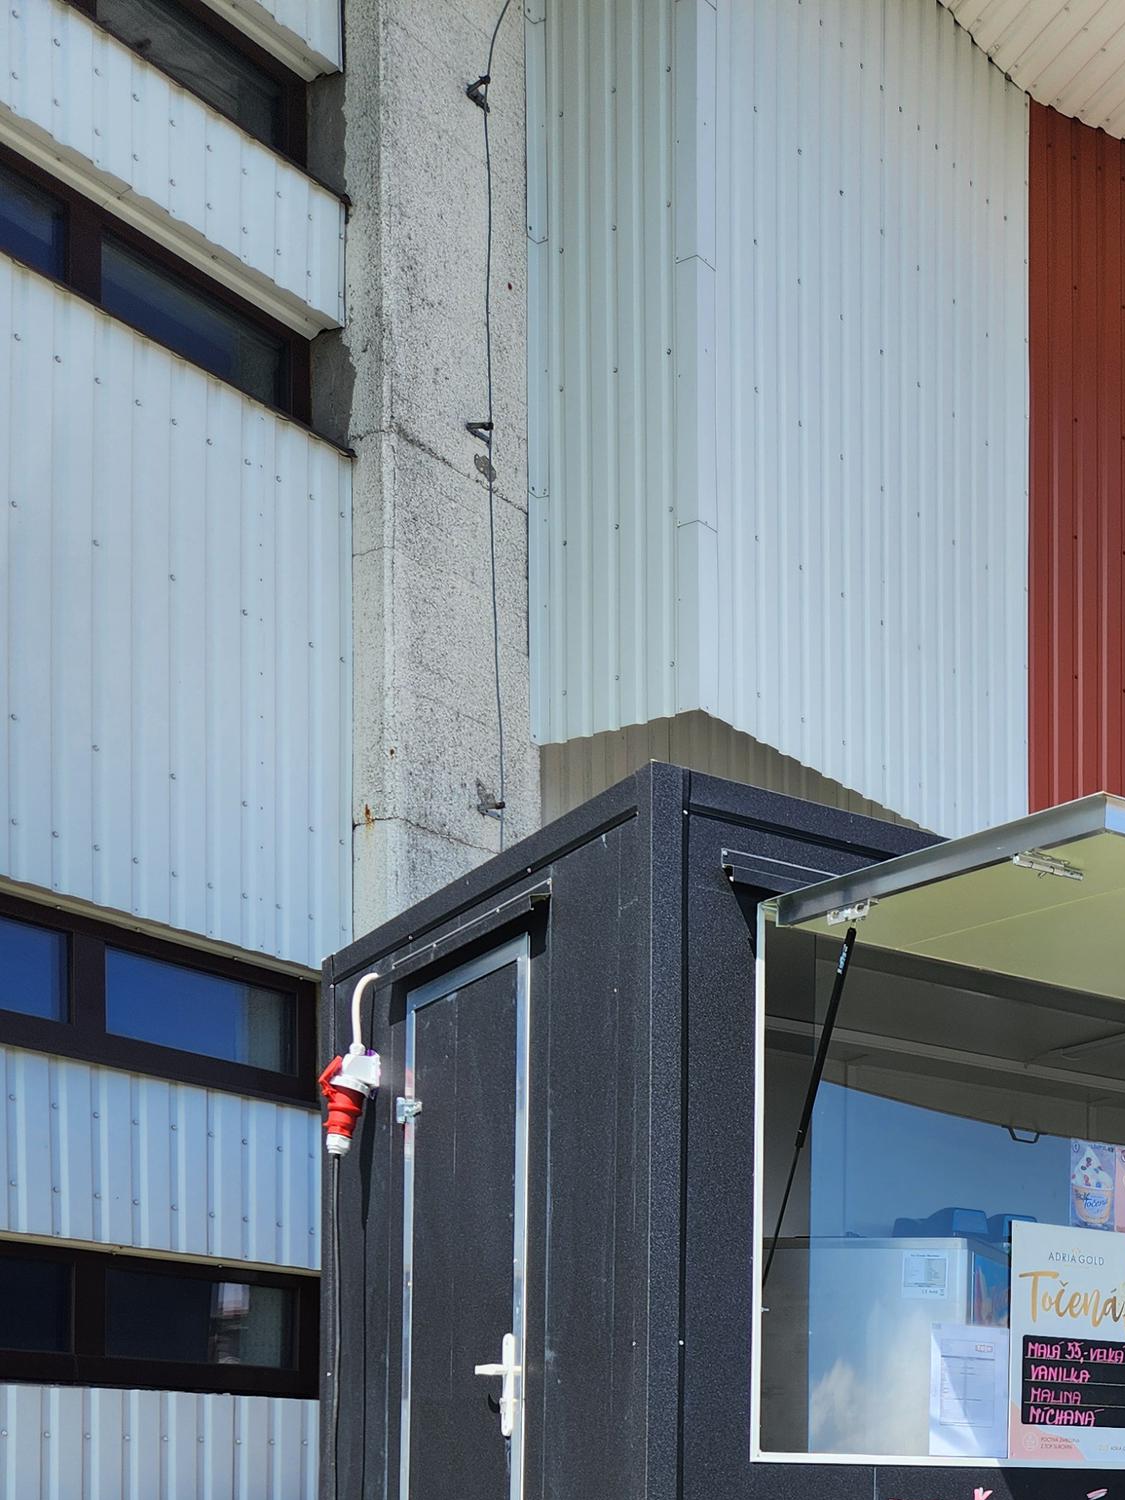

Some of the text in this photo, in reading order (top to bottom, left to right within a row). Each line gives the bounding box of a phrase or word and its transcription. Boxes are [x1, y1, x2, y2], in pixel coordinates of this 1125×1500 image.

[1048, 1251, 1105, 1266] ADRIA GOLD
[1018, 1270, 1125, 1328] Točená
[1027, 1341, 1065, 1360] MALÁ
[1030, 1364, 1091, 1383] VANILKA
[1030, 1387, 1081, 1405] MALINA
[1029, 1405, 1104, 1427] MÍCHANÁ
